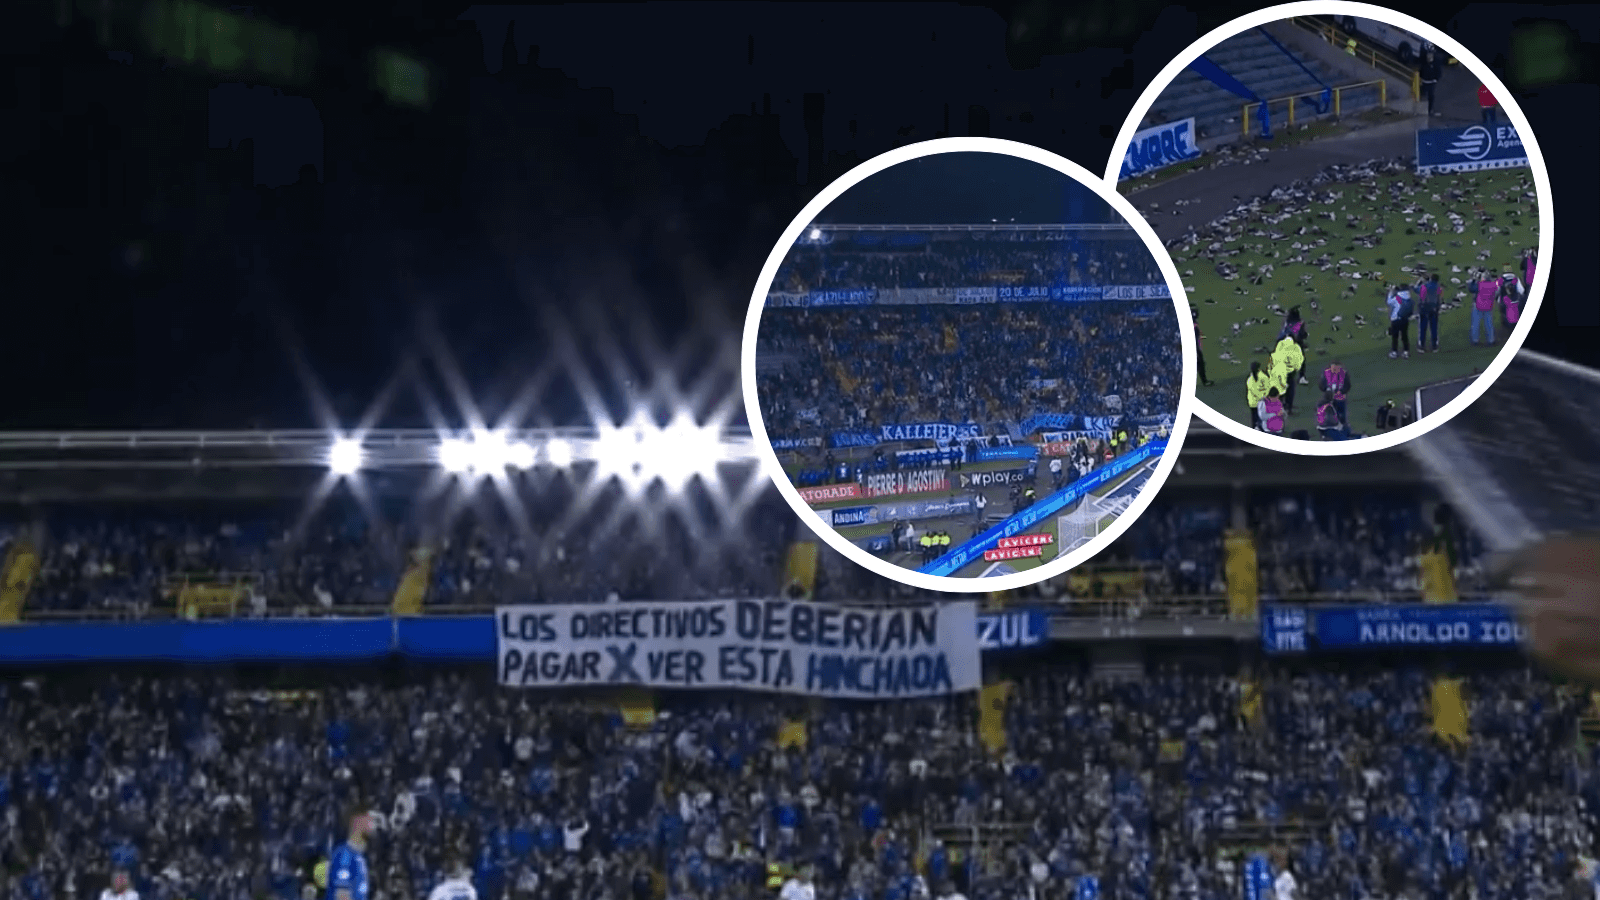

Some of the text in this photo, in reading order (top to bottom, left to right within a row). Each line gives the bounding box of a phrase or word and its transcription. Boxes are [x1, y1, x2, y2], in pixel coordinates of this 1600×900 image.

[868, 472, 896, 496] PIERRE
[907, 469, 946, 493] AGOSTINY
[972, 471, 1024, 486] Wplay.co
[834, 511, 865, 524] ANDINA
[502, 602, 938, 648] LOS DIRECTIVOS DEBERIAN
[977, 616, 1038, 649] ZUL
[1360, 621, 1470, 643] ARNOLDO
[503, 642, 951, 692] PAGAR X VER ESTA HINCHADA
